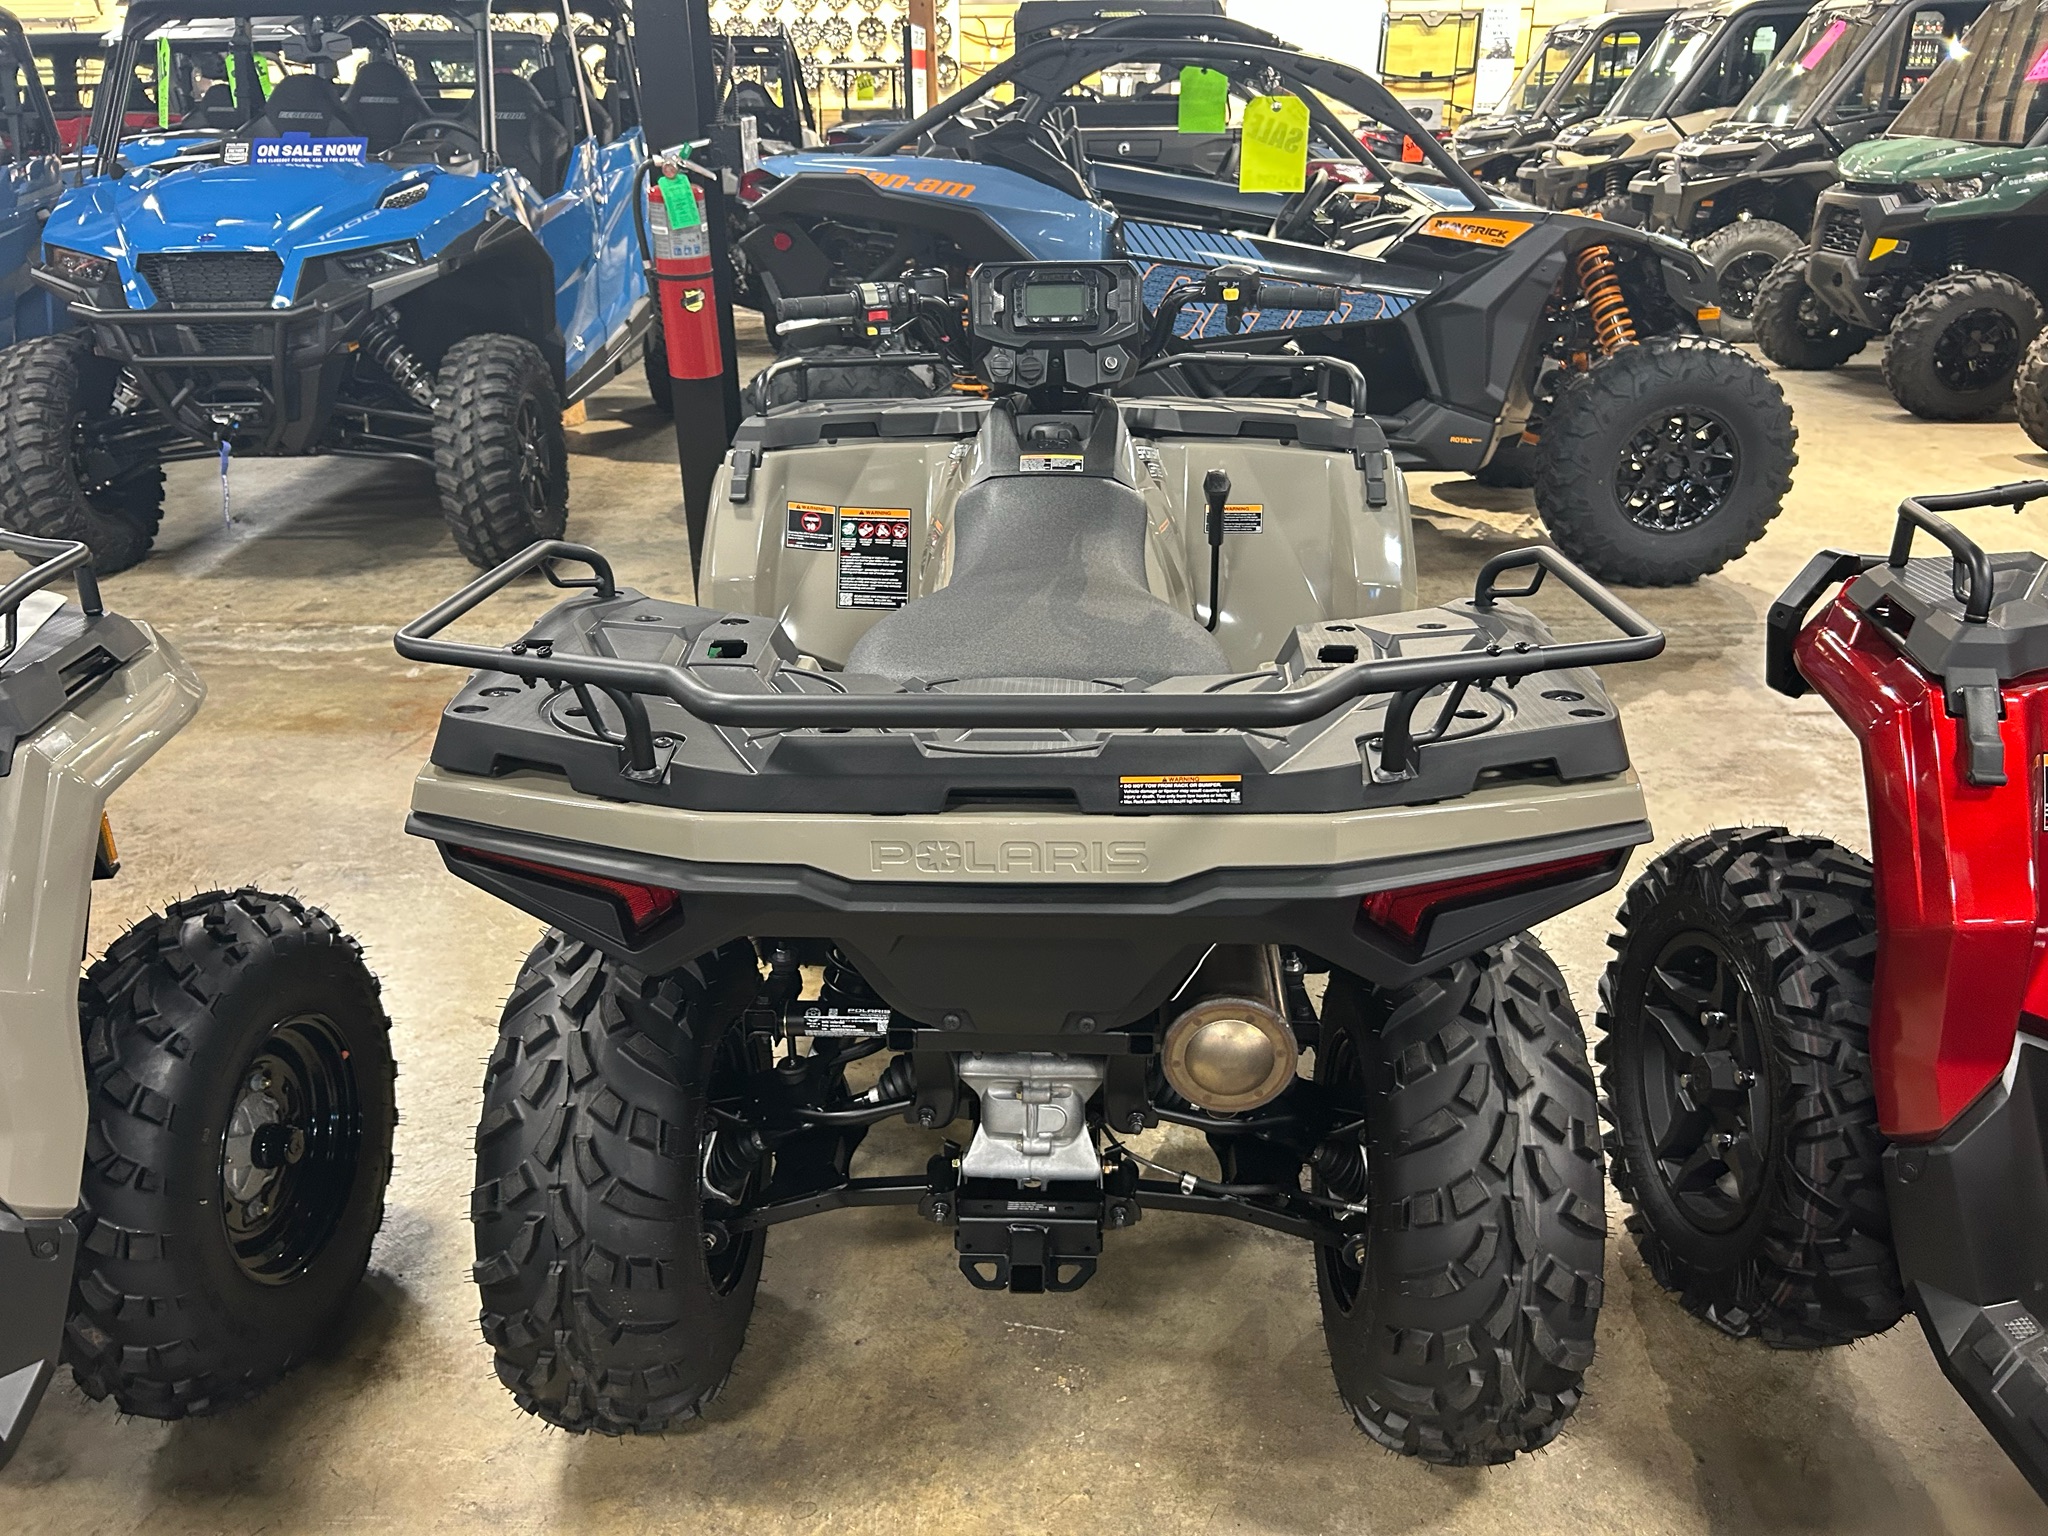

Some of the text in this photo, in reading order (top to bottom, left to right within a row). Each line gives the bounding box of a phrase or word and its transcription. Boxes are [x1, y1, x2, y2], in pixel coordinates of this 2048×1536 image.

[257, 144, 280, 157] ON
[281, 144, 323, 156] SALE
[325, 144, 362, 156] NOW
[318, 208, 381, 242] 1000
[1434, 219, 1509, 239] MAVERICK
[1450, 436, 1473, 444] ROTAX
[870, 840, 1150, 874] POLARIS
